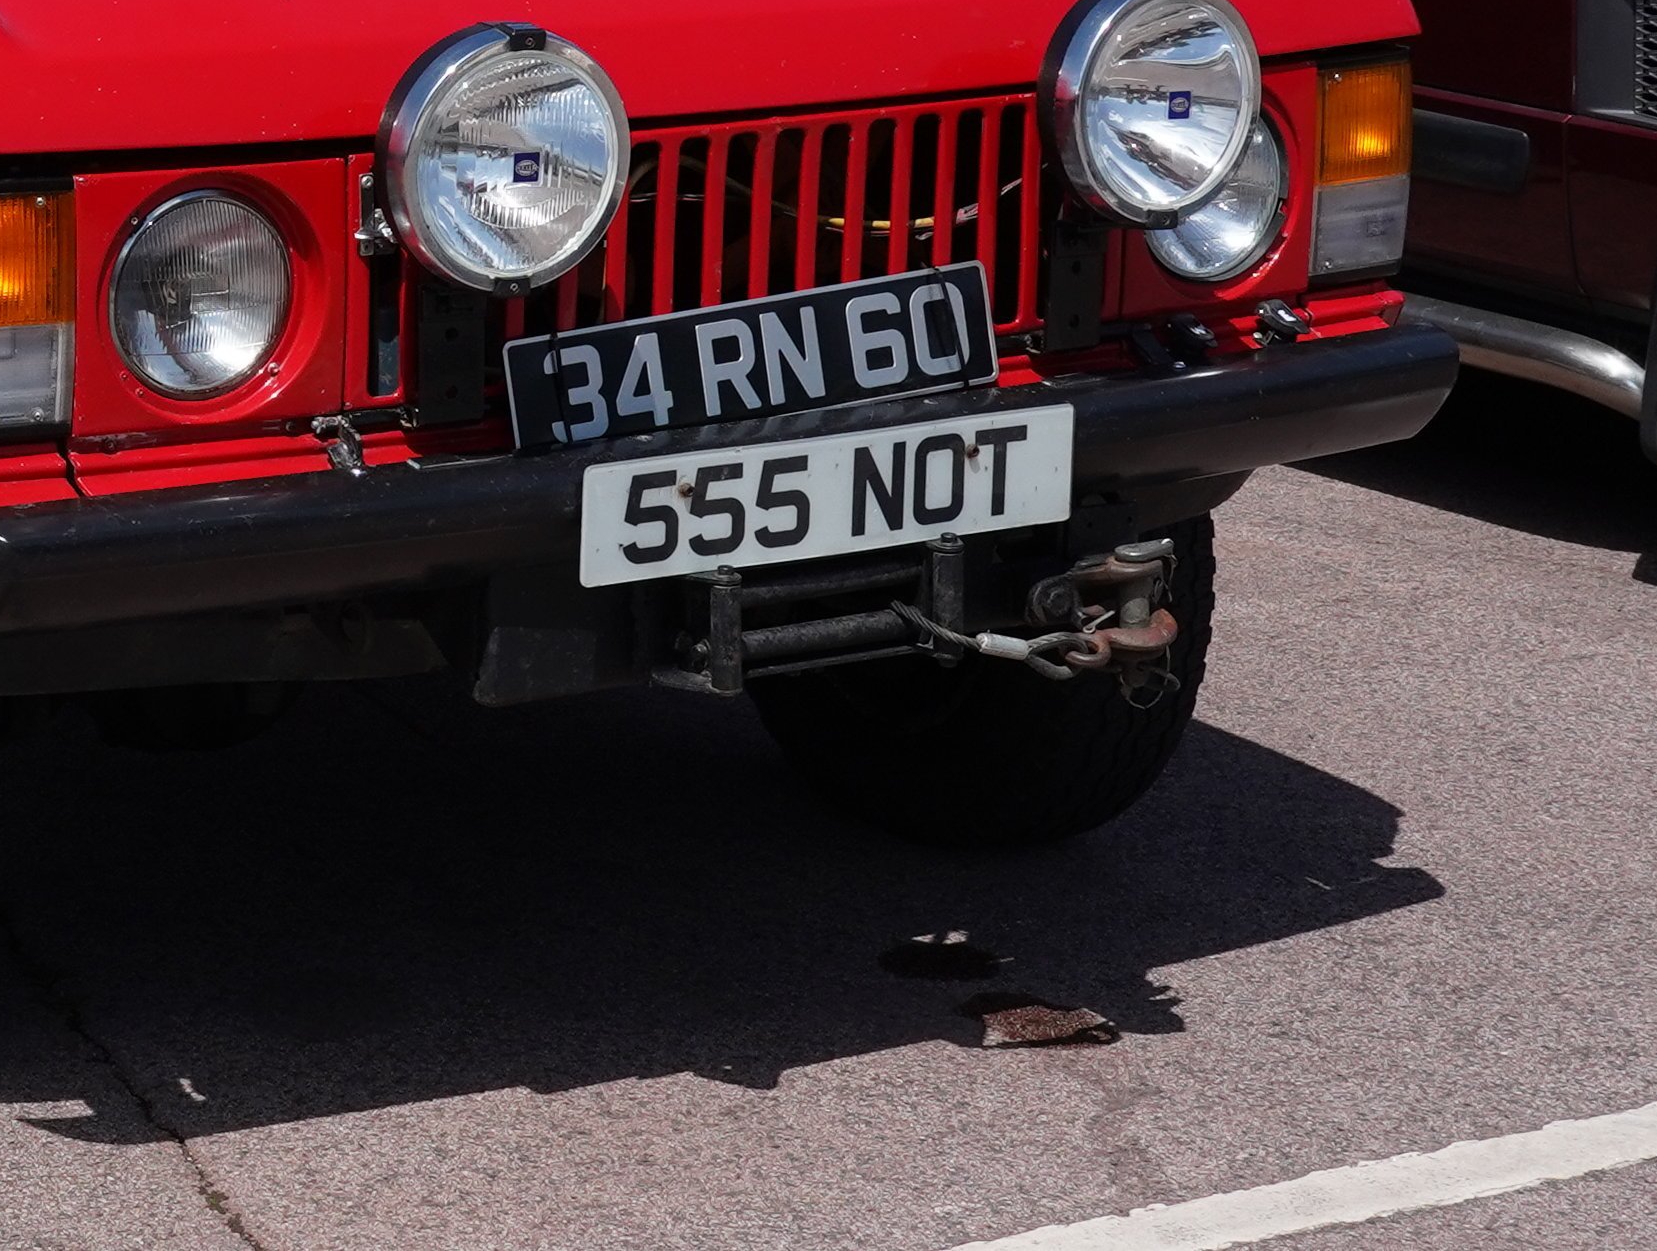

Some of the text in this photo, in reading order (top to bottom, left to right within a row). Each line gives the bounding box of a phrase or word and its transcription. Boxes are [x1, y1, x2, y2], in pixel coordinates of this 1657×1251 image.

[543, 281, 971, 443] 34 RN 60
[621, 425, 1028, 565] 555 NOT
